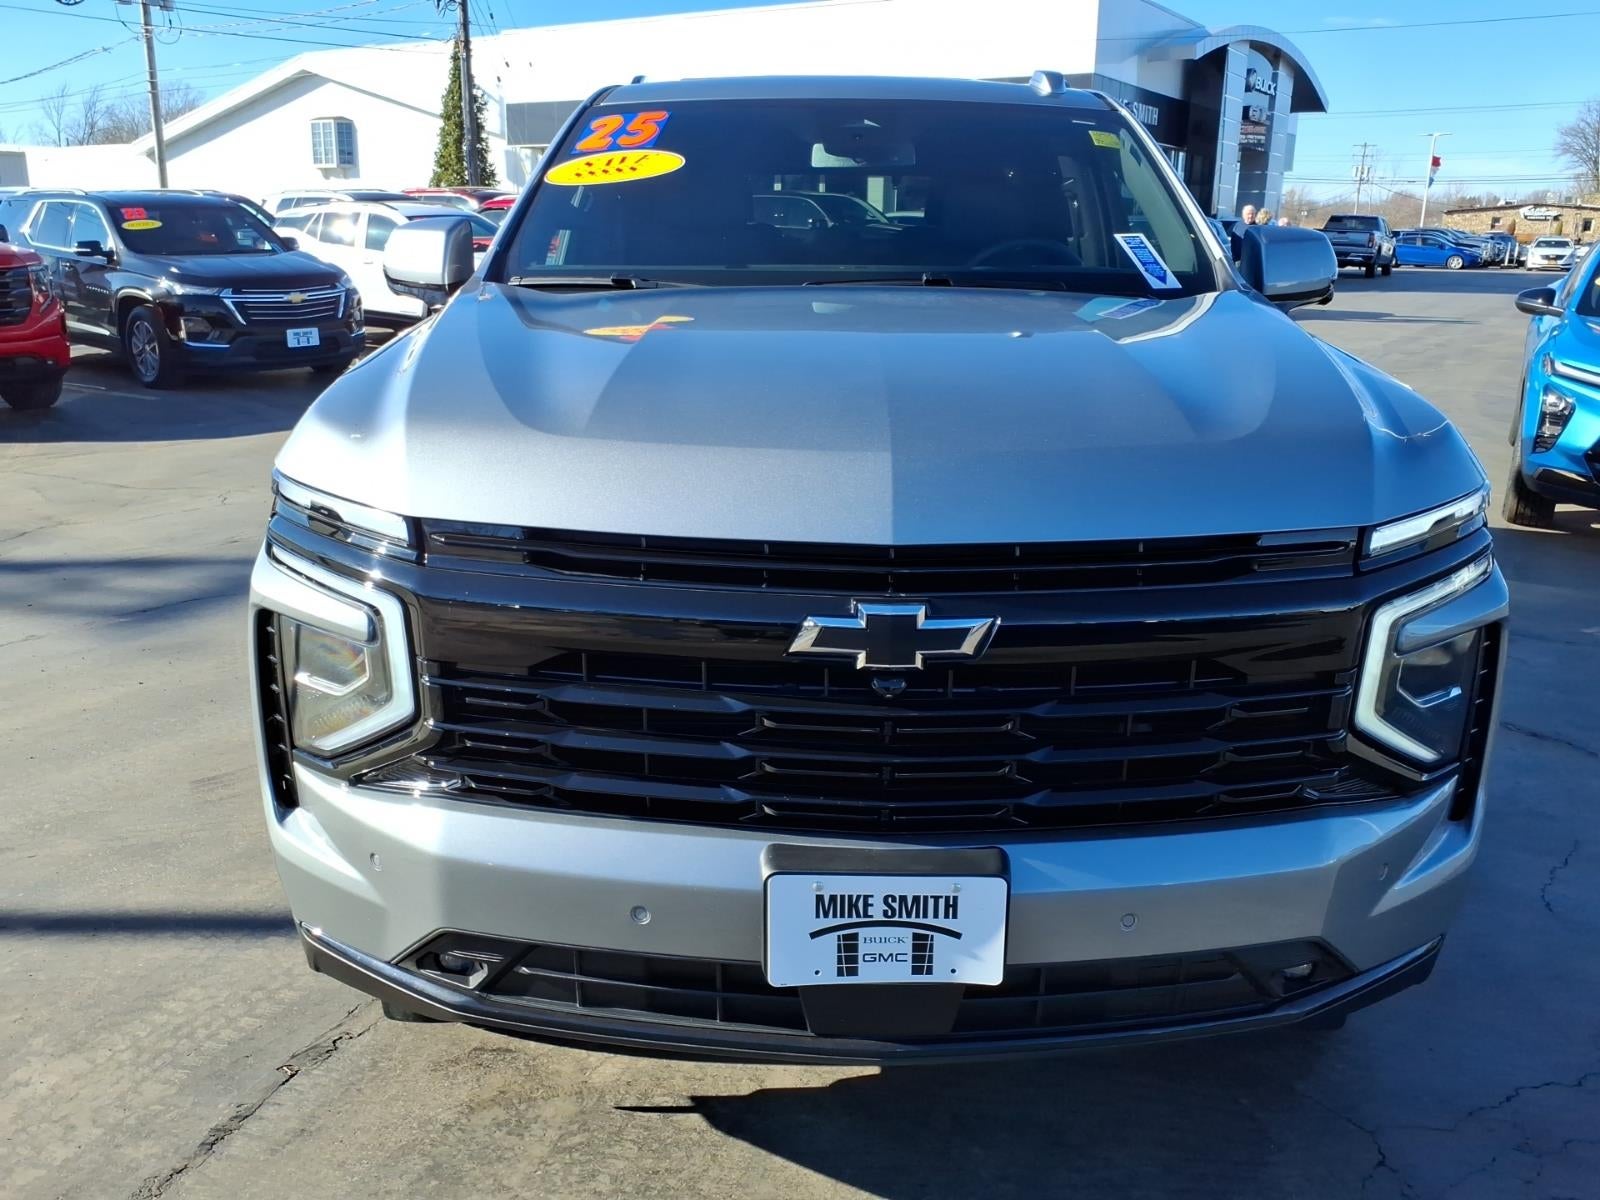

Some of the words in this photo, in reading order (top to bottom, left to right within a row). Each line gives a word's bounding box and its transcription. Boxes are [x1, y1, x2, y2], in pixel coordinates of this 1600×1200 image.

[1255, 77, 1276, 95] BUICK
[1133, 102, 1158, 126] SMITH
[576, 111, 669, 152] 25
[815, 894, 874, 919] MIKE
[882, 894, 959, 919] SMITH
[863, 936, 906, 944] BUICK
[862, 953, 908, 963] GMC
